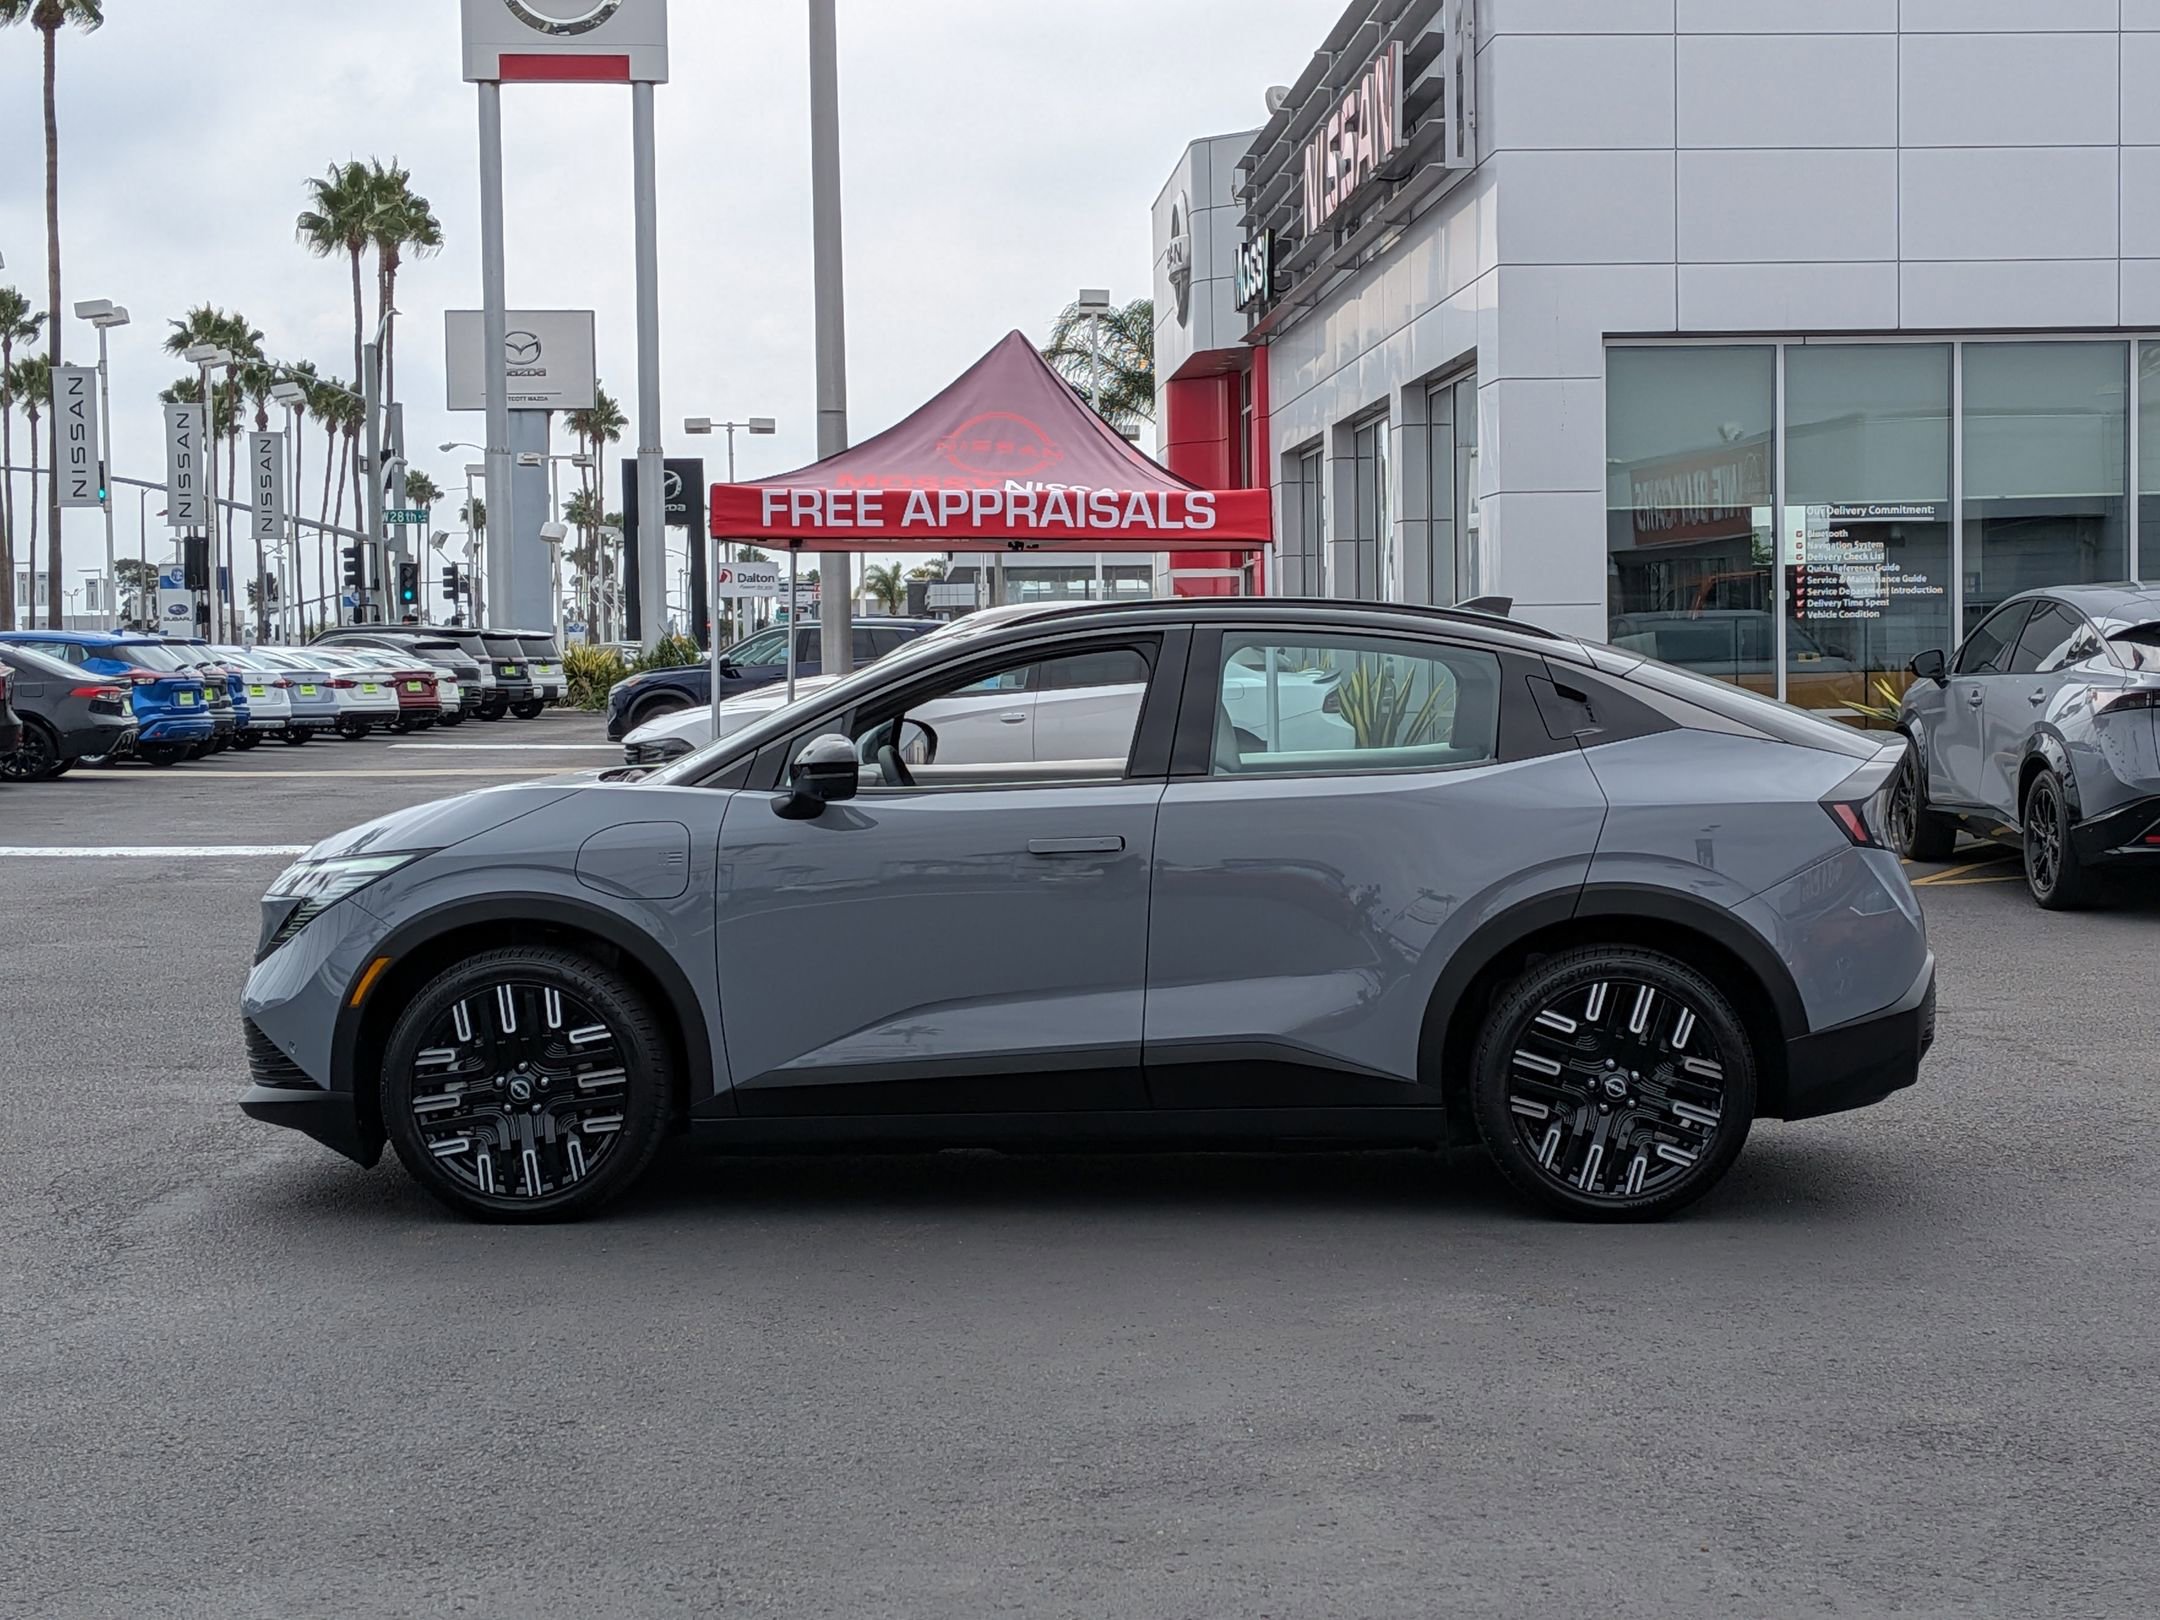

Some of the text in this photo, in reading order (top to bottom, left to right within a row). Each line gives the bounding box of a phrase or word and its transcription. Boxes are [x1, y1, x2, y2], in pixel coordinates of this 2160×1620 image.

[1304, 41, 1403, 238] NISSAN
[1234, 228, 1270, 310] MOSSY
[506, 368, 546, 377] azda
[68, 376, 88, 498] NISSAN
[176, 412, 193, 518] NISSAN
[259, 439, 274, 532] NISSAN
[761, 488, 1217, 529] FREE APPRAISALS
[1827, 505, 1866, 517] Delivery
[1868, 505, 1935, 515] Commitment:
[1807, 541, 1884, 552] Navigation System
[1807, 552, 1885, 562] Delivery Check List
[1807, 563, 1901, 573] Quick Reference Guide
[737, 572, 775, 583] Dalton
[1806, 576, 1838, 584] Service
[1902, 574, 1928, 583] Guide
[1806, 586, 1944, 596] Service Department Introduction
[1806, 599, 1890, 608] Delivery Time Spent
[1806, 610, 1880, 618] Vehicle Condition
